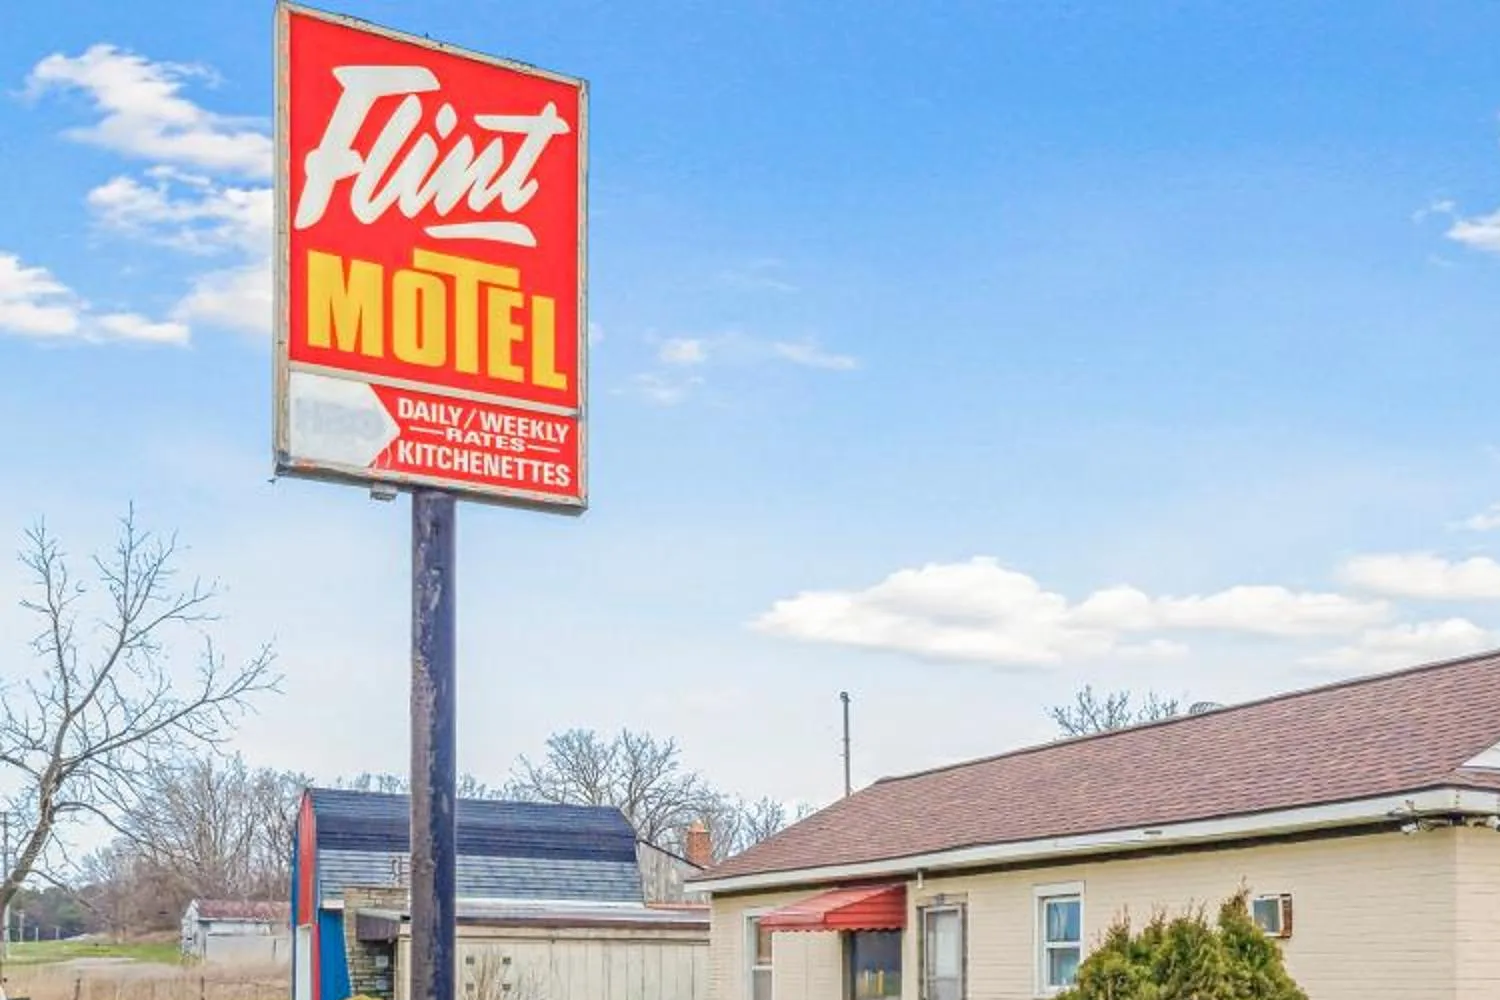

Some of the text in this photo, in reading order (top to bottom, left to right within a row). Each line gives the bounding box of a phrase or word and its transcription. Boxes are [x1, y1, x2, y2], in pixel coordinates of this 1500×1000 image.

[294, 65, 570, 230] Flint
[306, 248, 567, 391] MOTEL
[398, 440, 571, 487] KITCHENETTES
[446, 428, 526, 452] RATES
